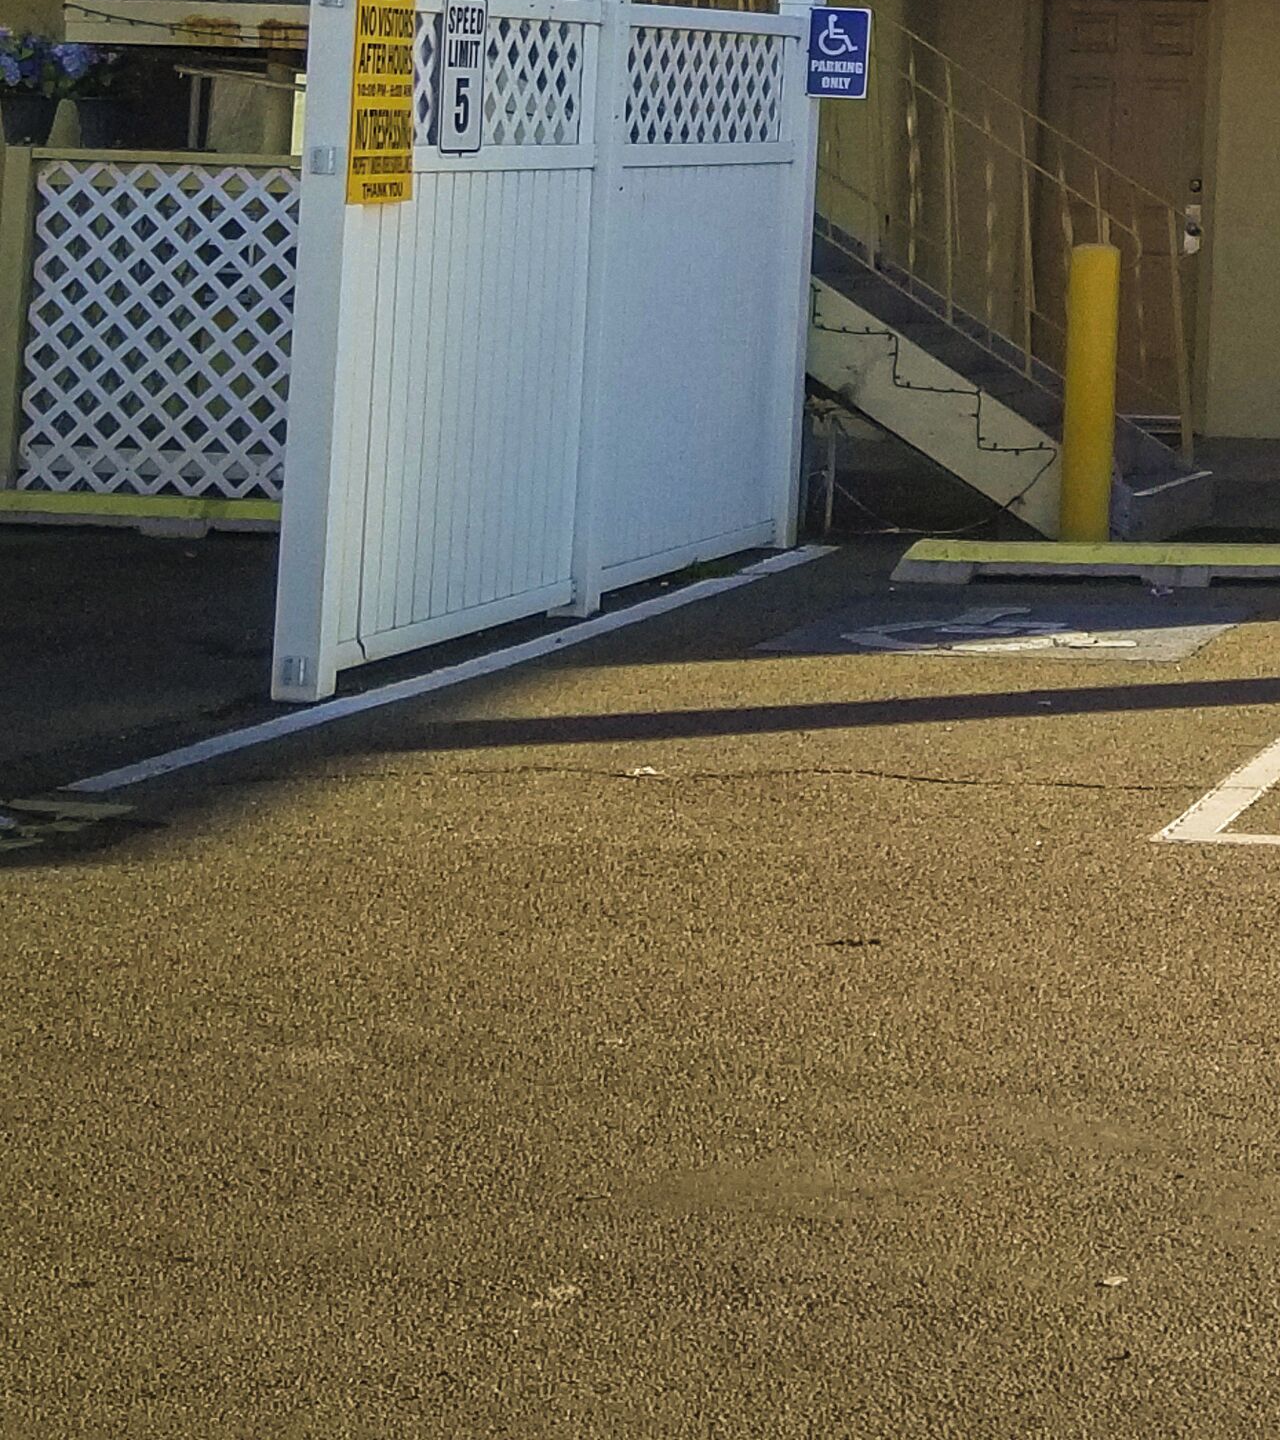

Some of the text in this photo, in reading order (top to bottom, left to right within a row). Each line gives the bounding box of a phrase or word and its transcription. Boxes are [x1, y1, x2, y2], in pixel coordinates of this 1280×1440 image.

[361, 6, 414, 38] NO VISITORS
[448, 6, 484, 35] SPEED
[358, 43, 413, 75] AFTER HOURS
[448, 39, 480, 68] LIMIT
[811, 59, 864, 74] PARKING
[821, 76, 852, 90] ONLY
[454, 77, 470, 134] 5
[362, 181, 403, 200] THANK YOU
